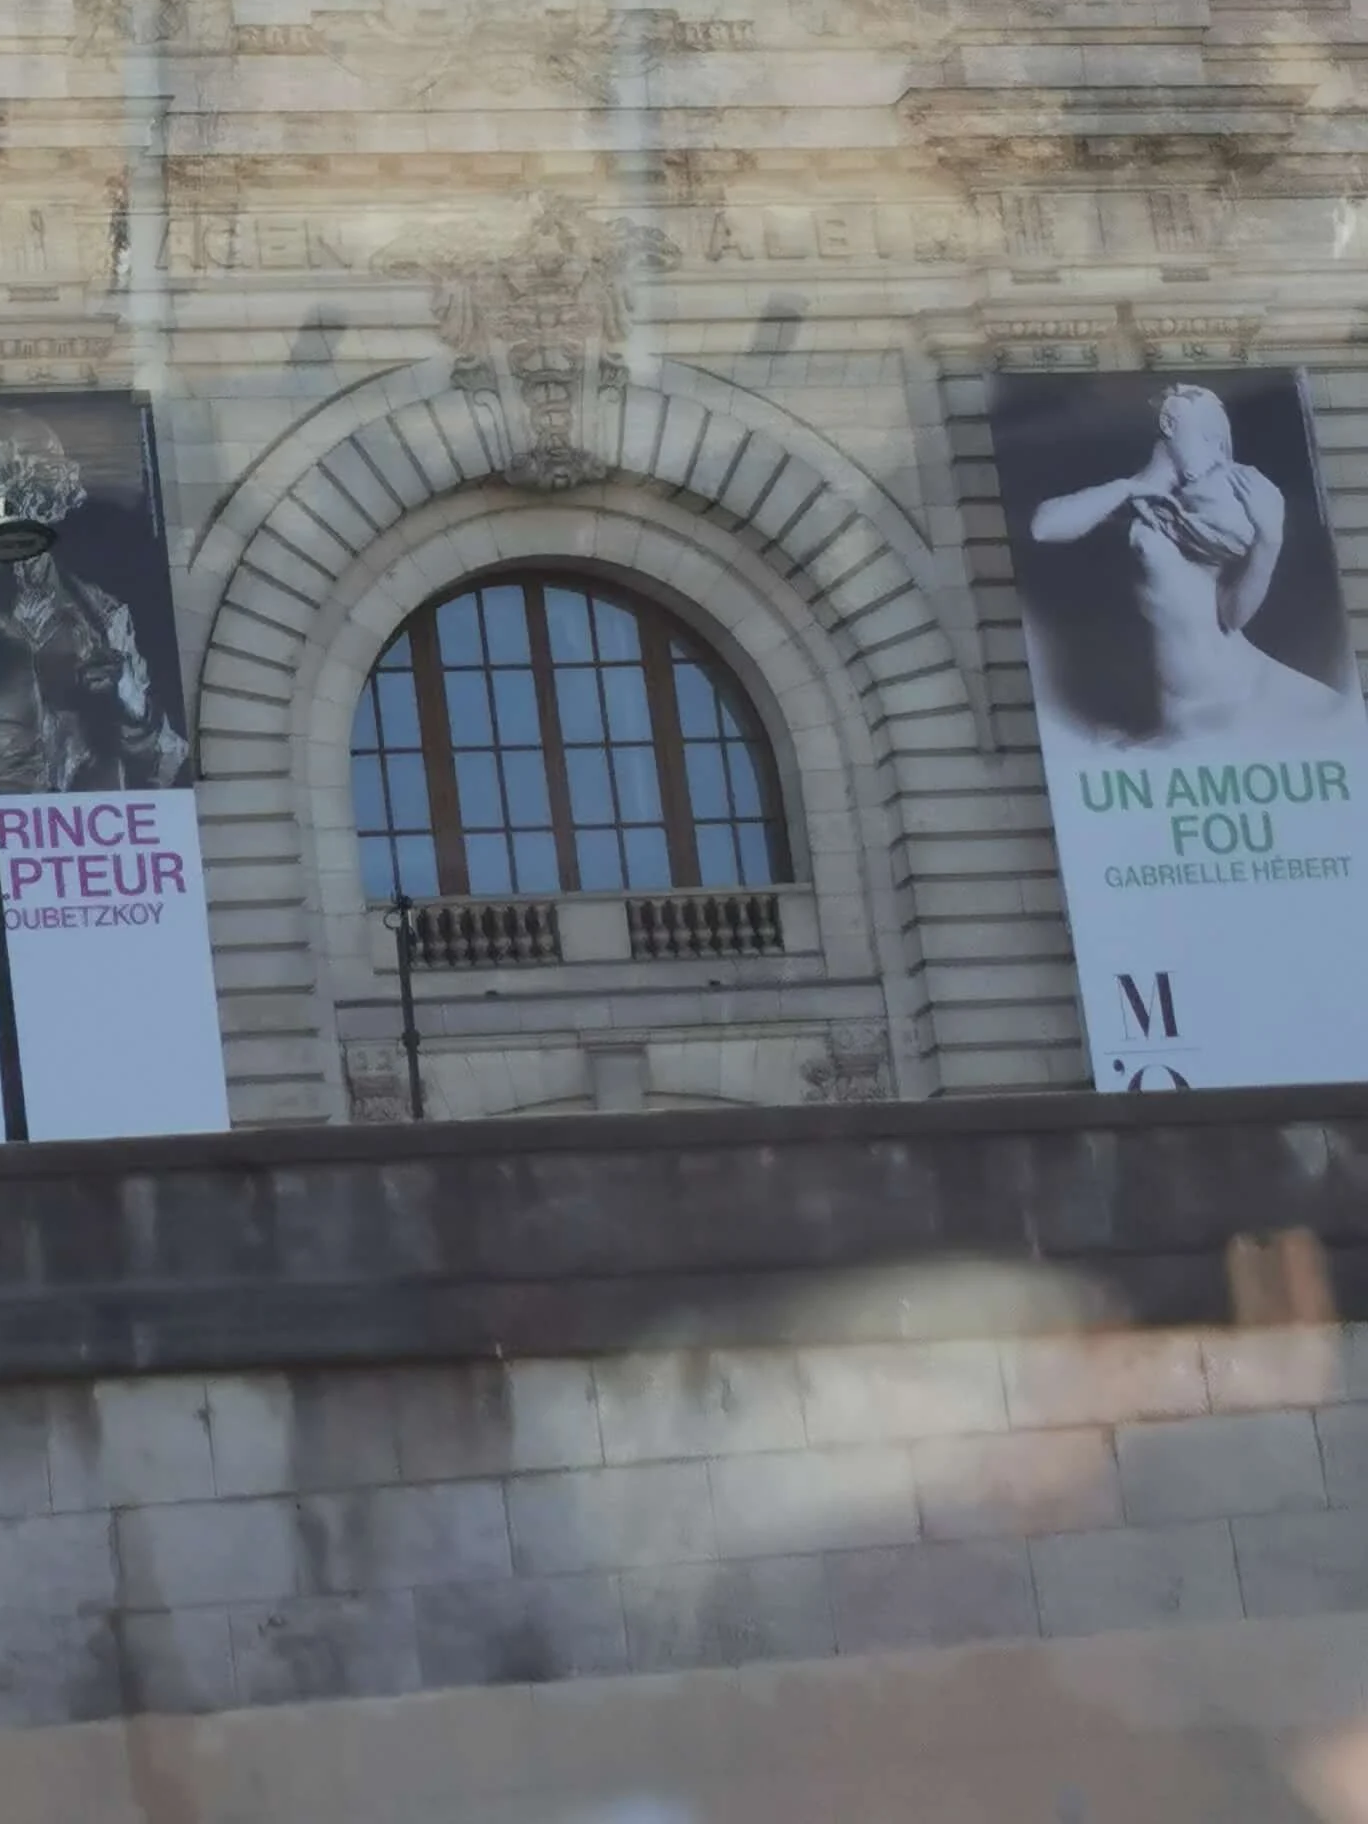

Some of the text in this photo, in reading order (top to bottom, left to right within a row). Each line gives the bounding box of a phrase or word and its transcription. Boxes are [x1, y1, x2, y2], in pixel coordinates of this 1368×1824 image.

[1080, 760, 1351, 812] UN AMOUR
[1170, 811, 1274, 856] FOU
[1104, 860, 1249, 888] GABRIELLE
[1113, 970, 1184, 1041] M
